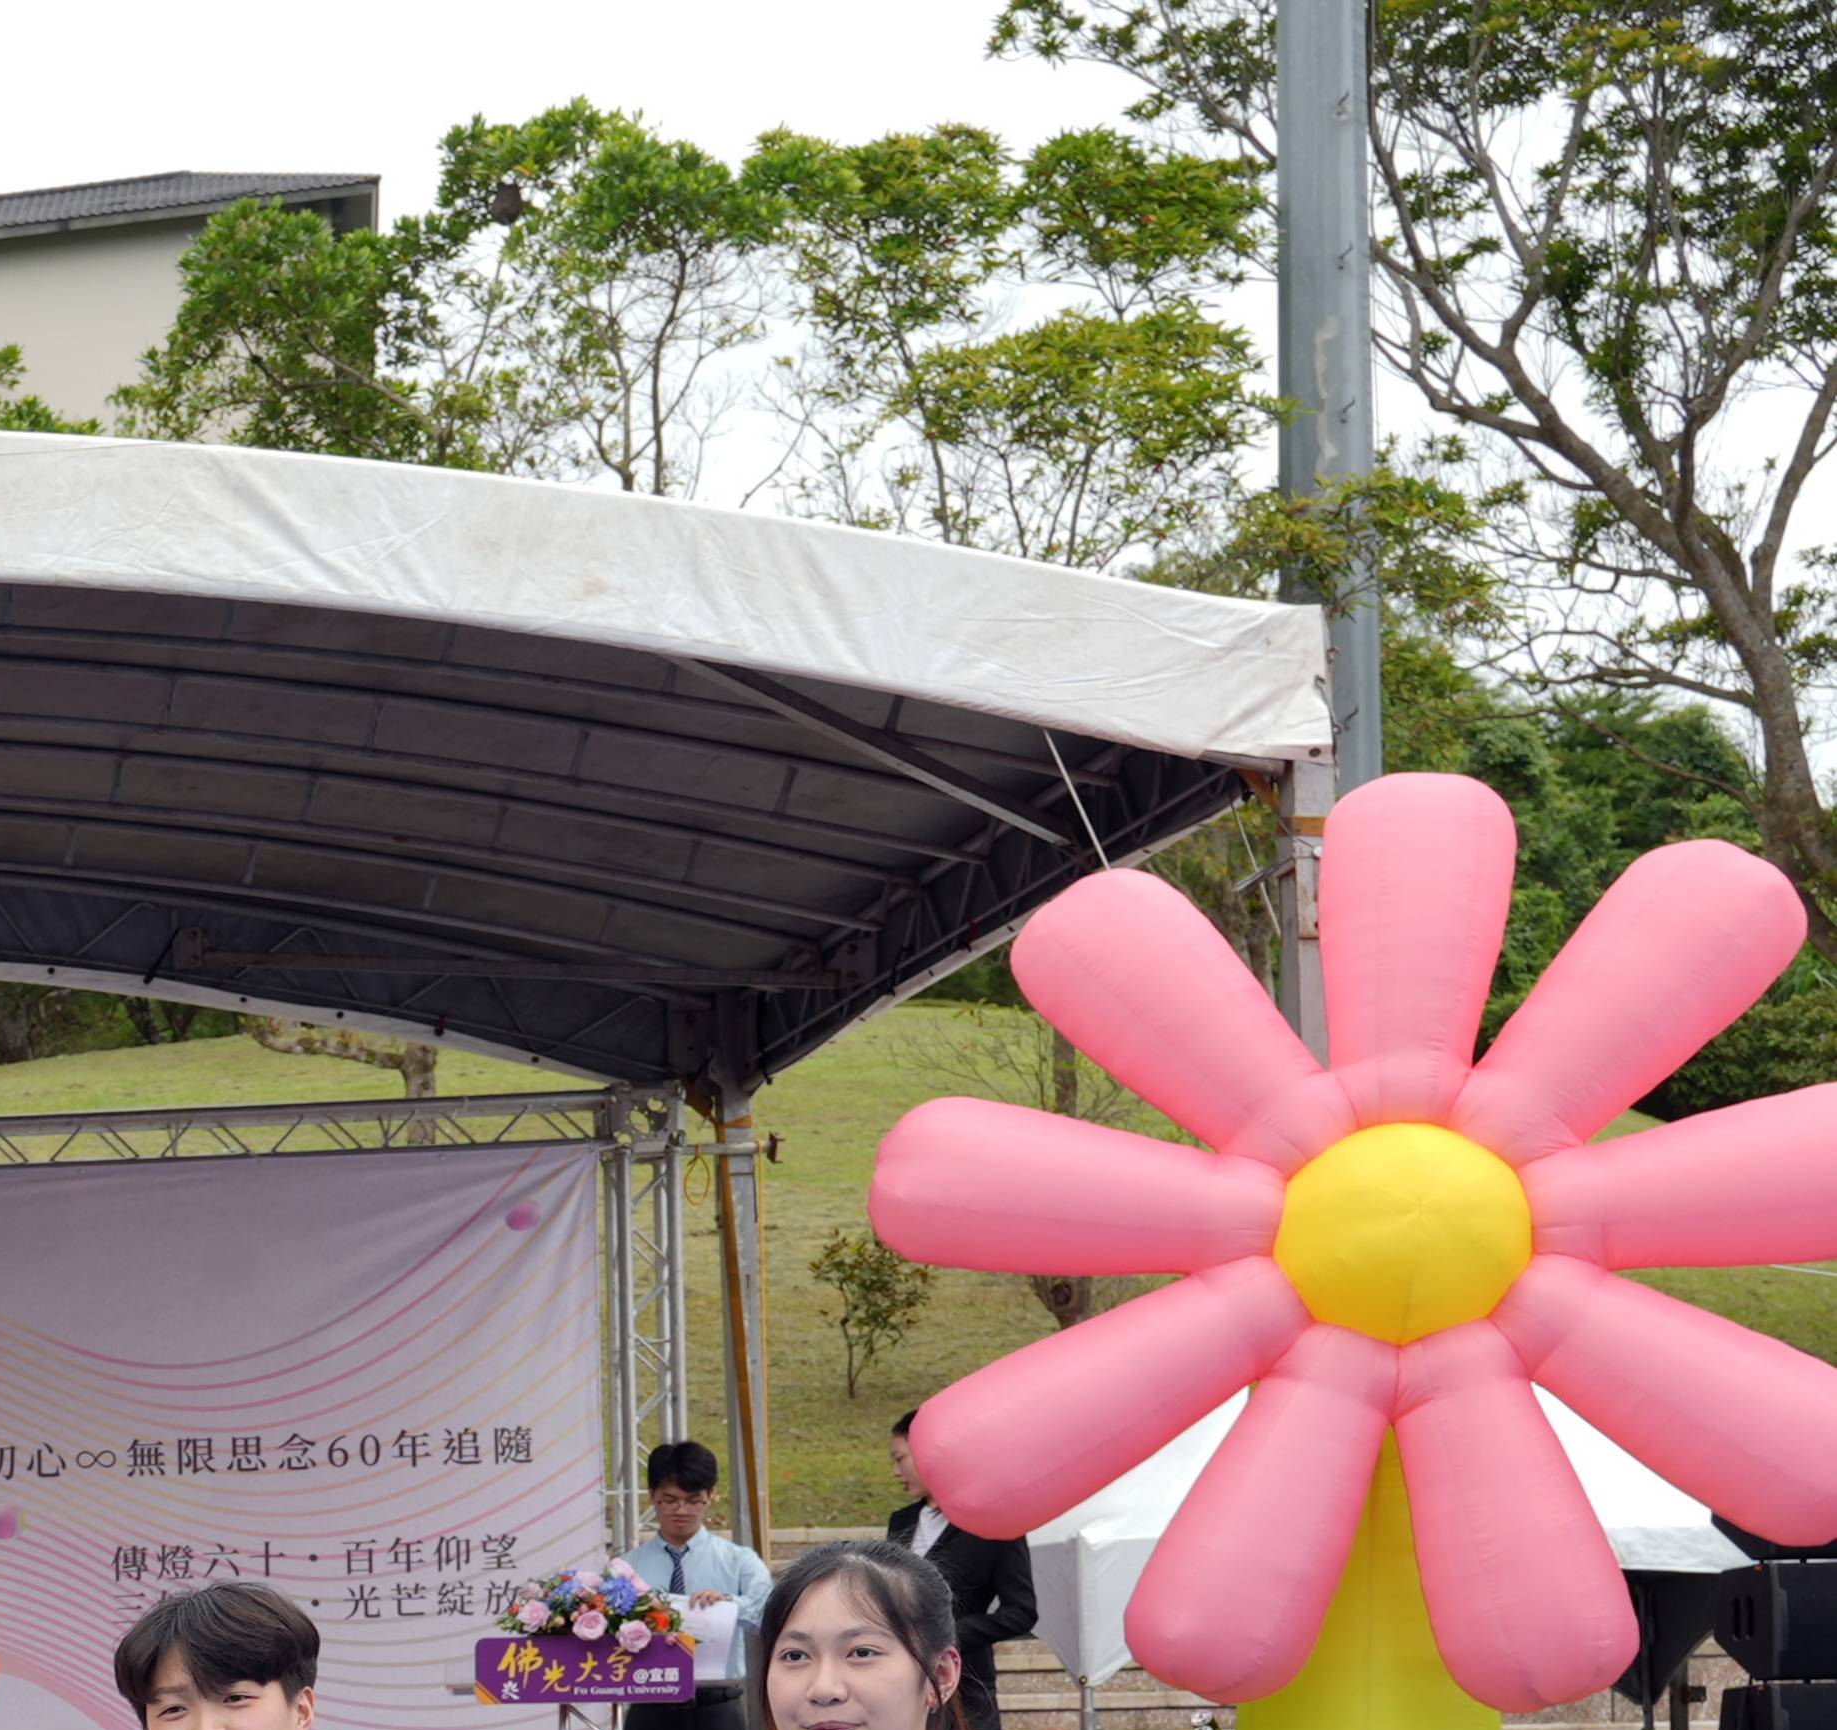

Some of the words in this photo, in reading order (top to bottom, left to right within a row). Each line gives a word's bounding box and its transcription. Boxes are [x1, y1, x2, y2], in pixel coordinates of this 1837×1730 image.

[574, 1686, 587, 1695] Fo
[590, 1686, 625, 1696] Guang
[628, 1685, 681, 1695] University
